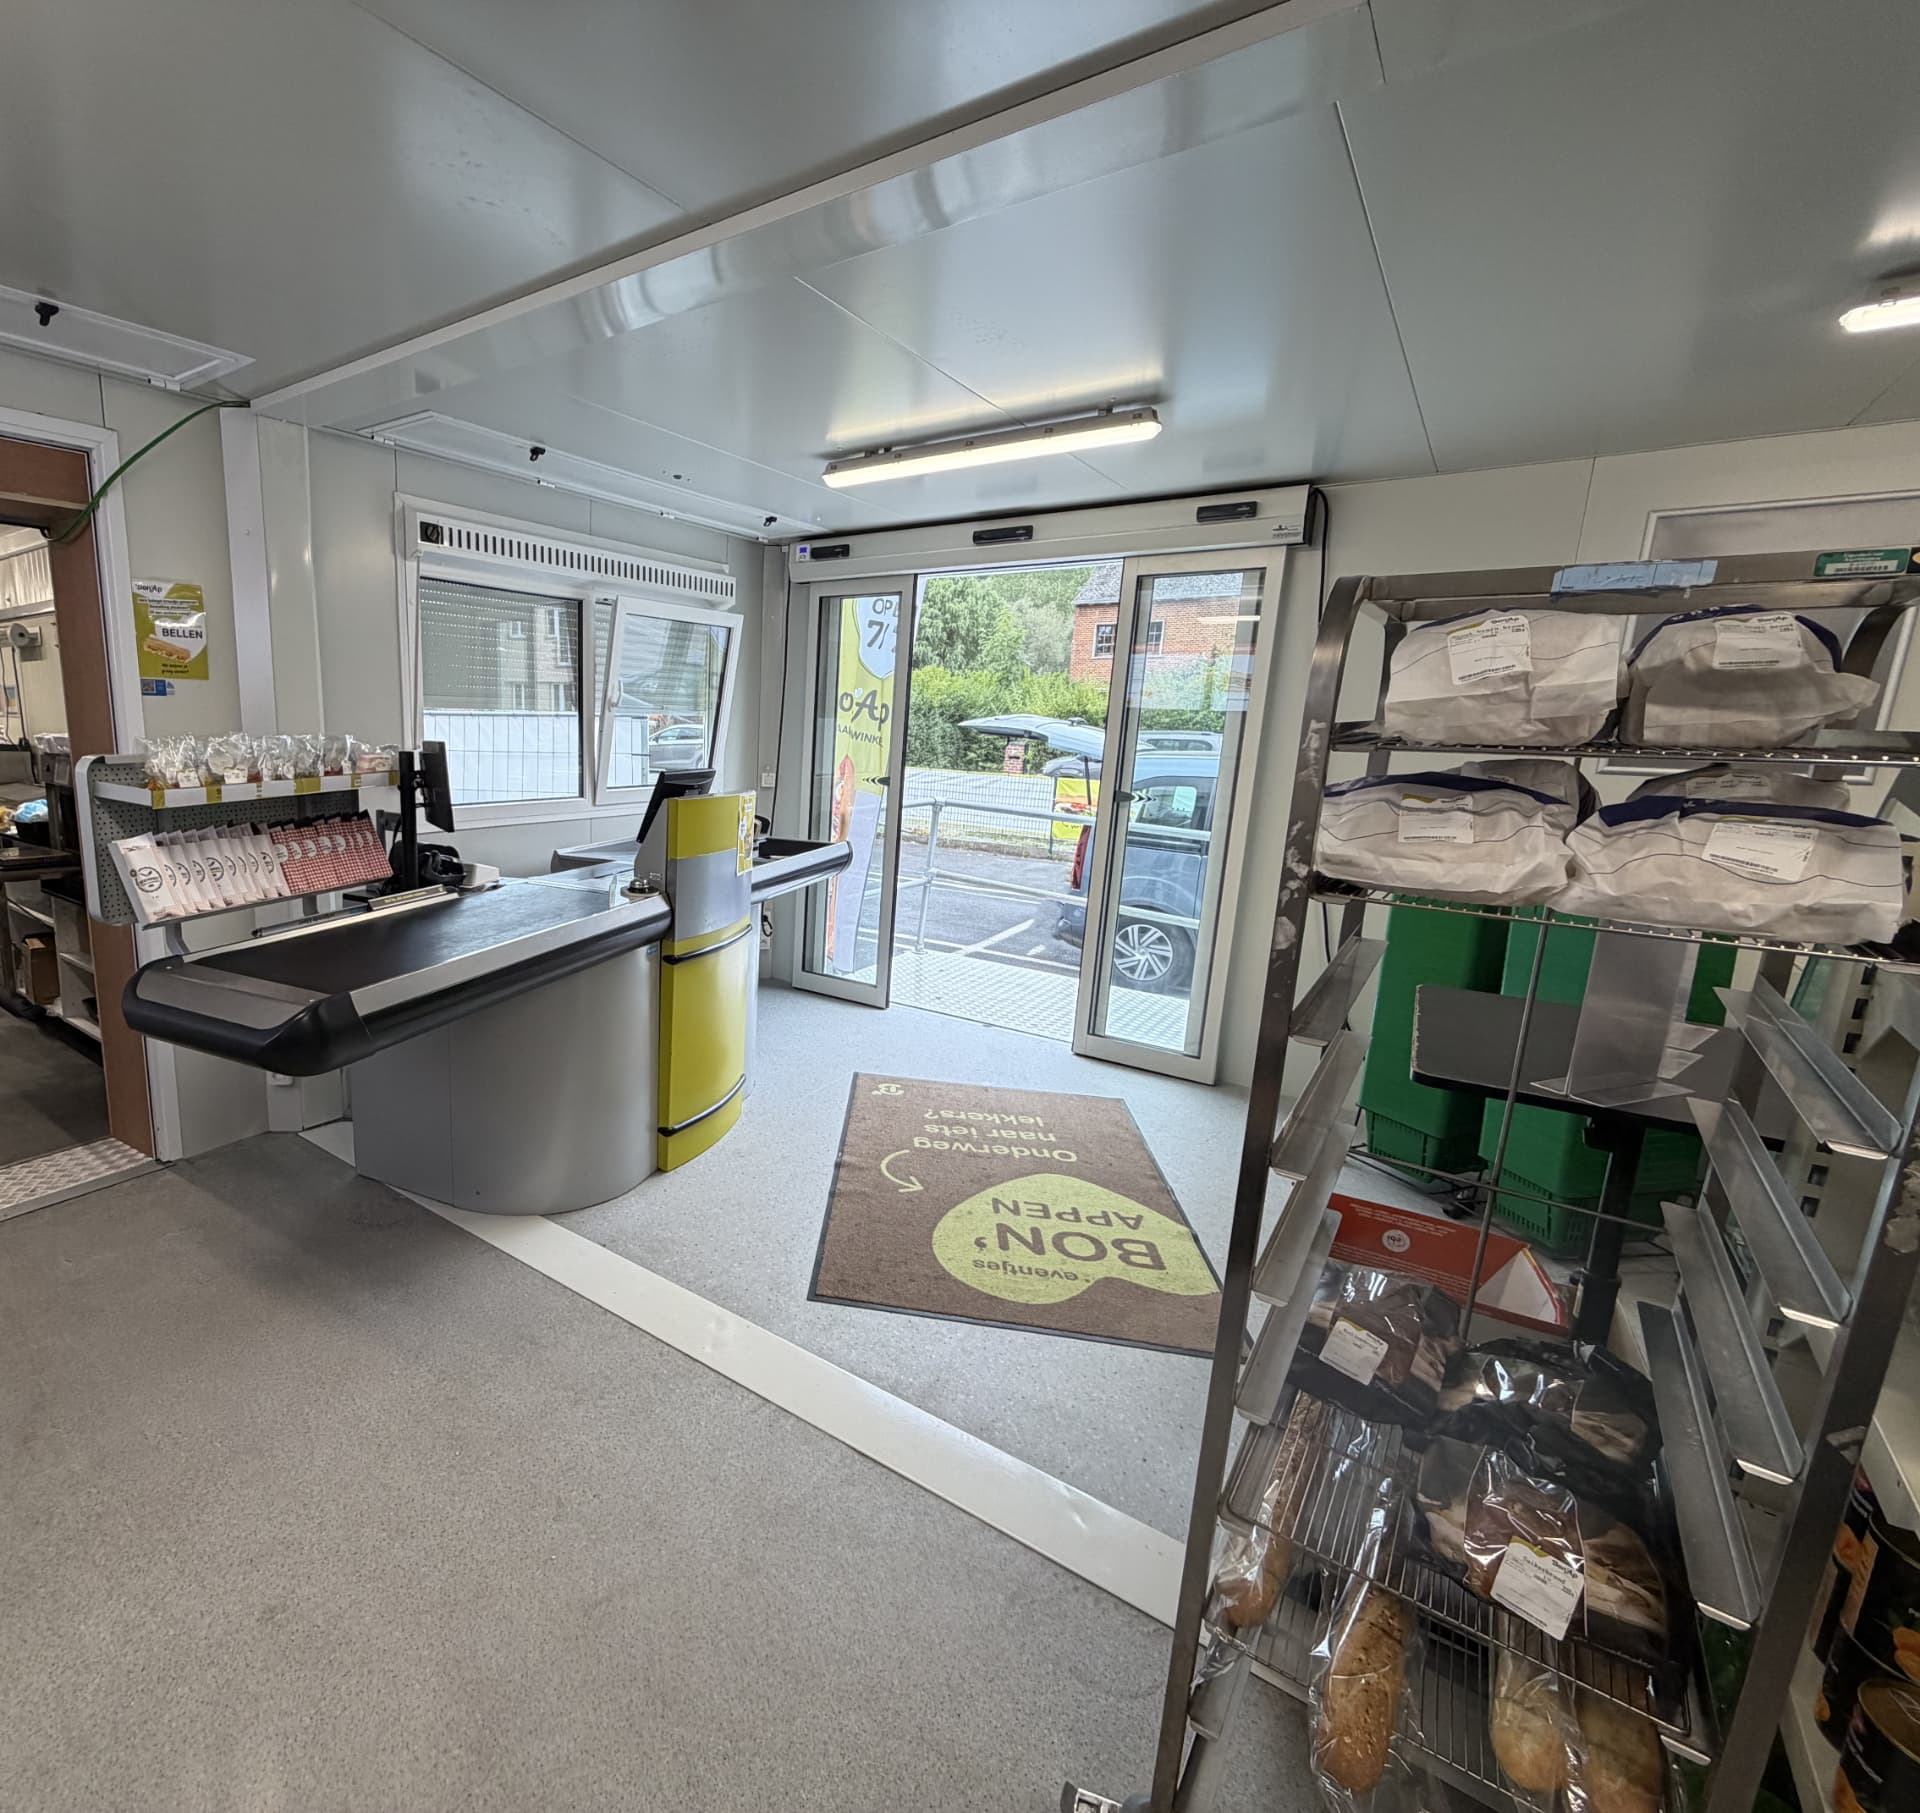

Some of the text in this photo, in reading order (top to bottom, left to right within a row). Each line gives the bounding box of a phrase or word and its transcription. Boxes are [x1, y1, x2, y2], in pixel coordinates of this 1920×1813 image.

[162, 628, 203, 640] BELLEN
[924, 1108, 1046, 1128] lekkers?
[923, 1123, 1057, 1145] naar iets
[912, 1136, 1078, 1163] Onderweg
[991, 1197, 1144, 1231] APPEN
